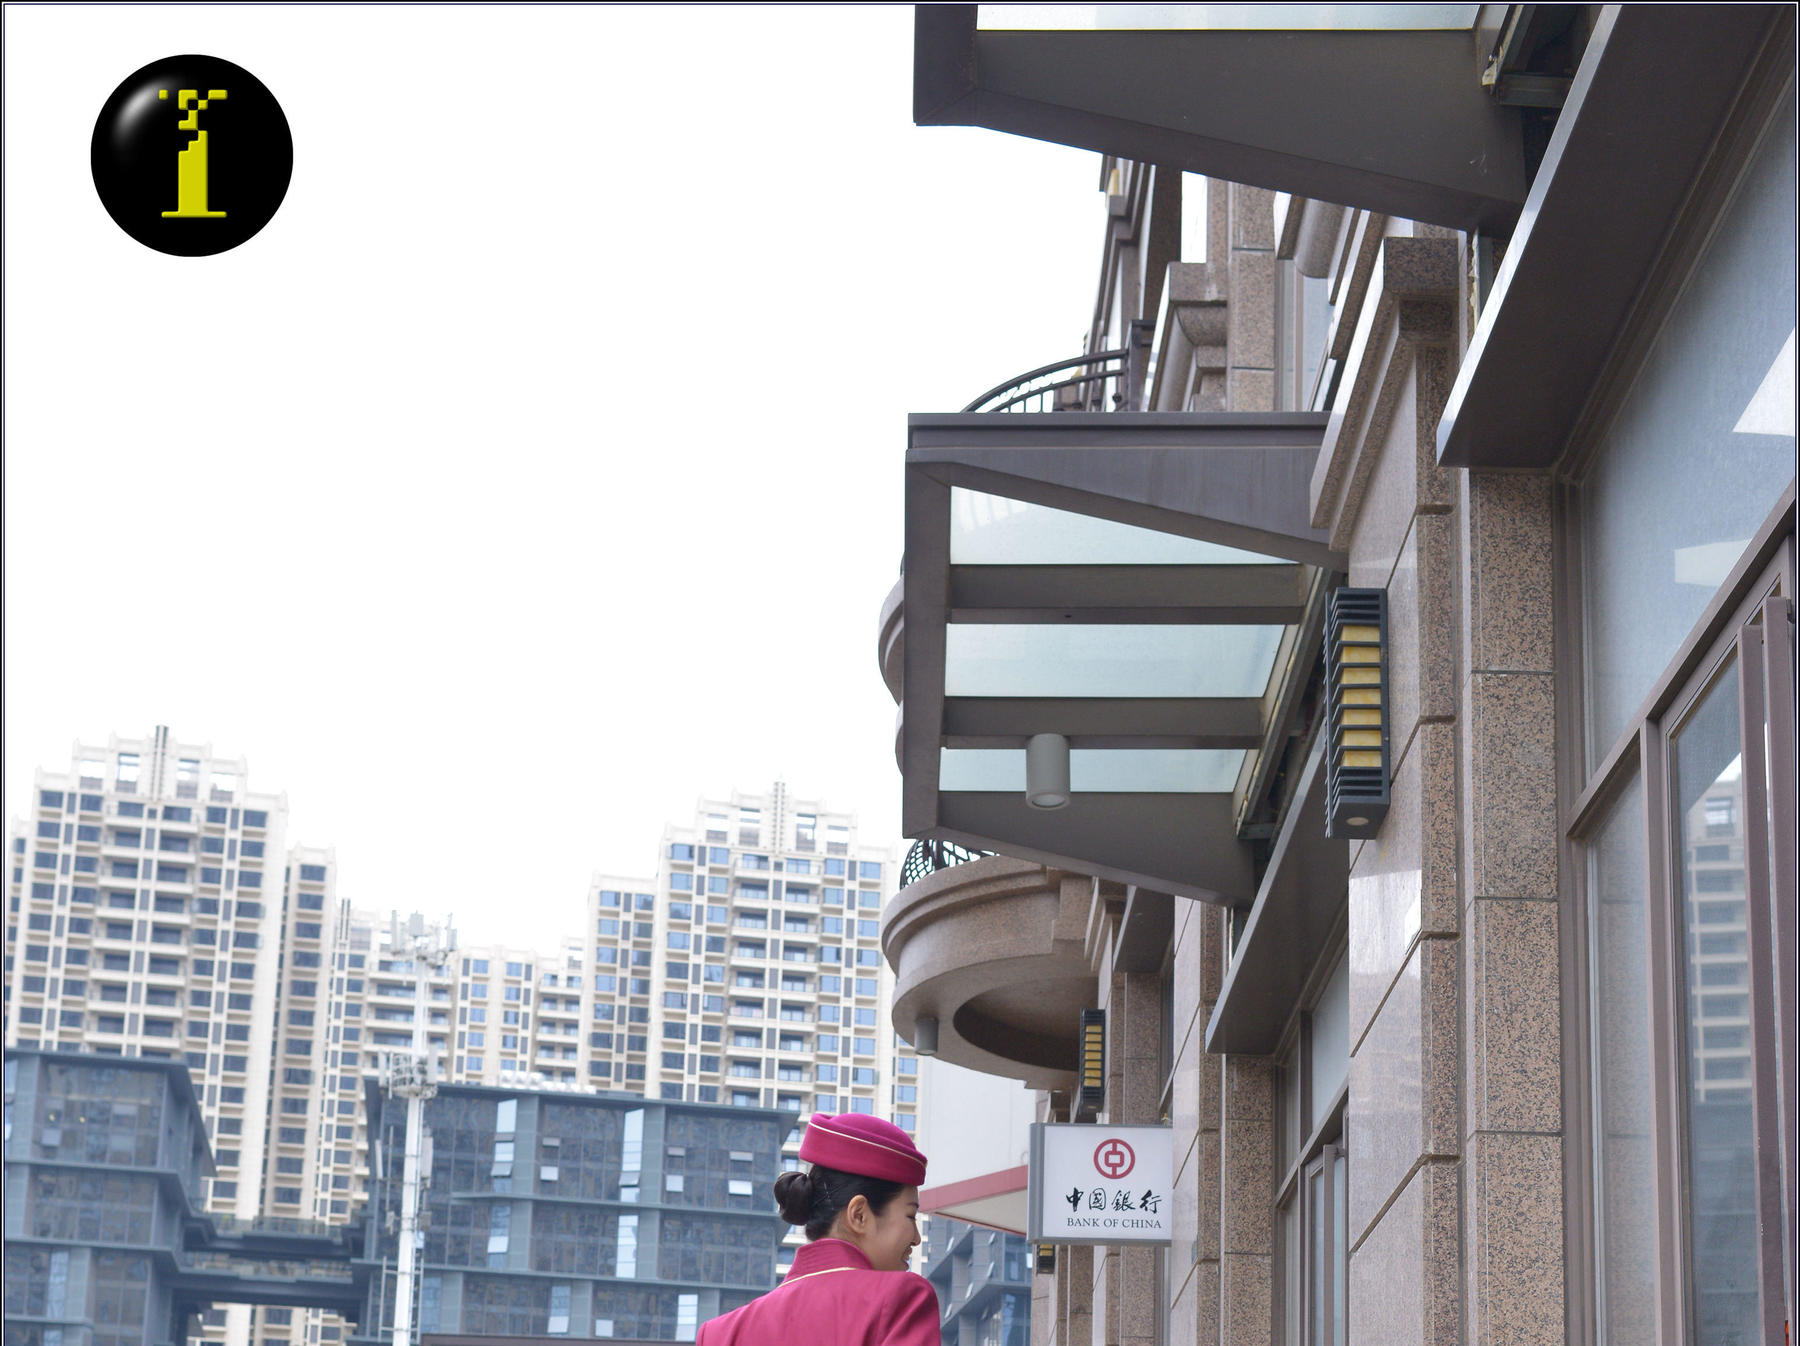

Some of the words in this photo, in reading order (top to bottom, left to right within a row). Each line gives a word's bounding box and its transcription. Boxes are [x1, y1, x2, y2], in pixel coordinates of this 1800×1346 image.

[1067, 1217, 1100, 1227] BANK
[1103, 1218, 1119, 1228] OF
[1121, 1219, 1162, 1229] CHINA
